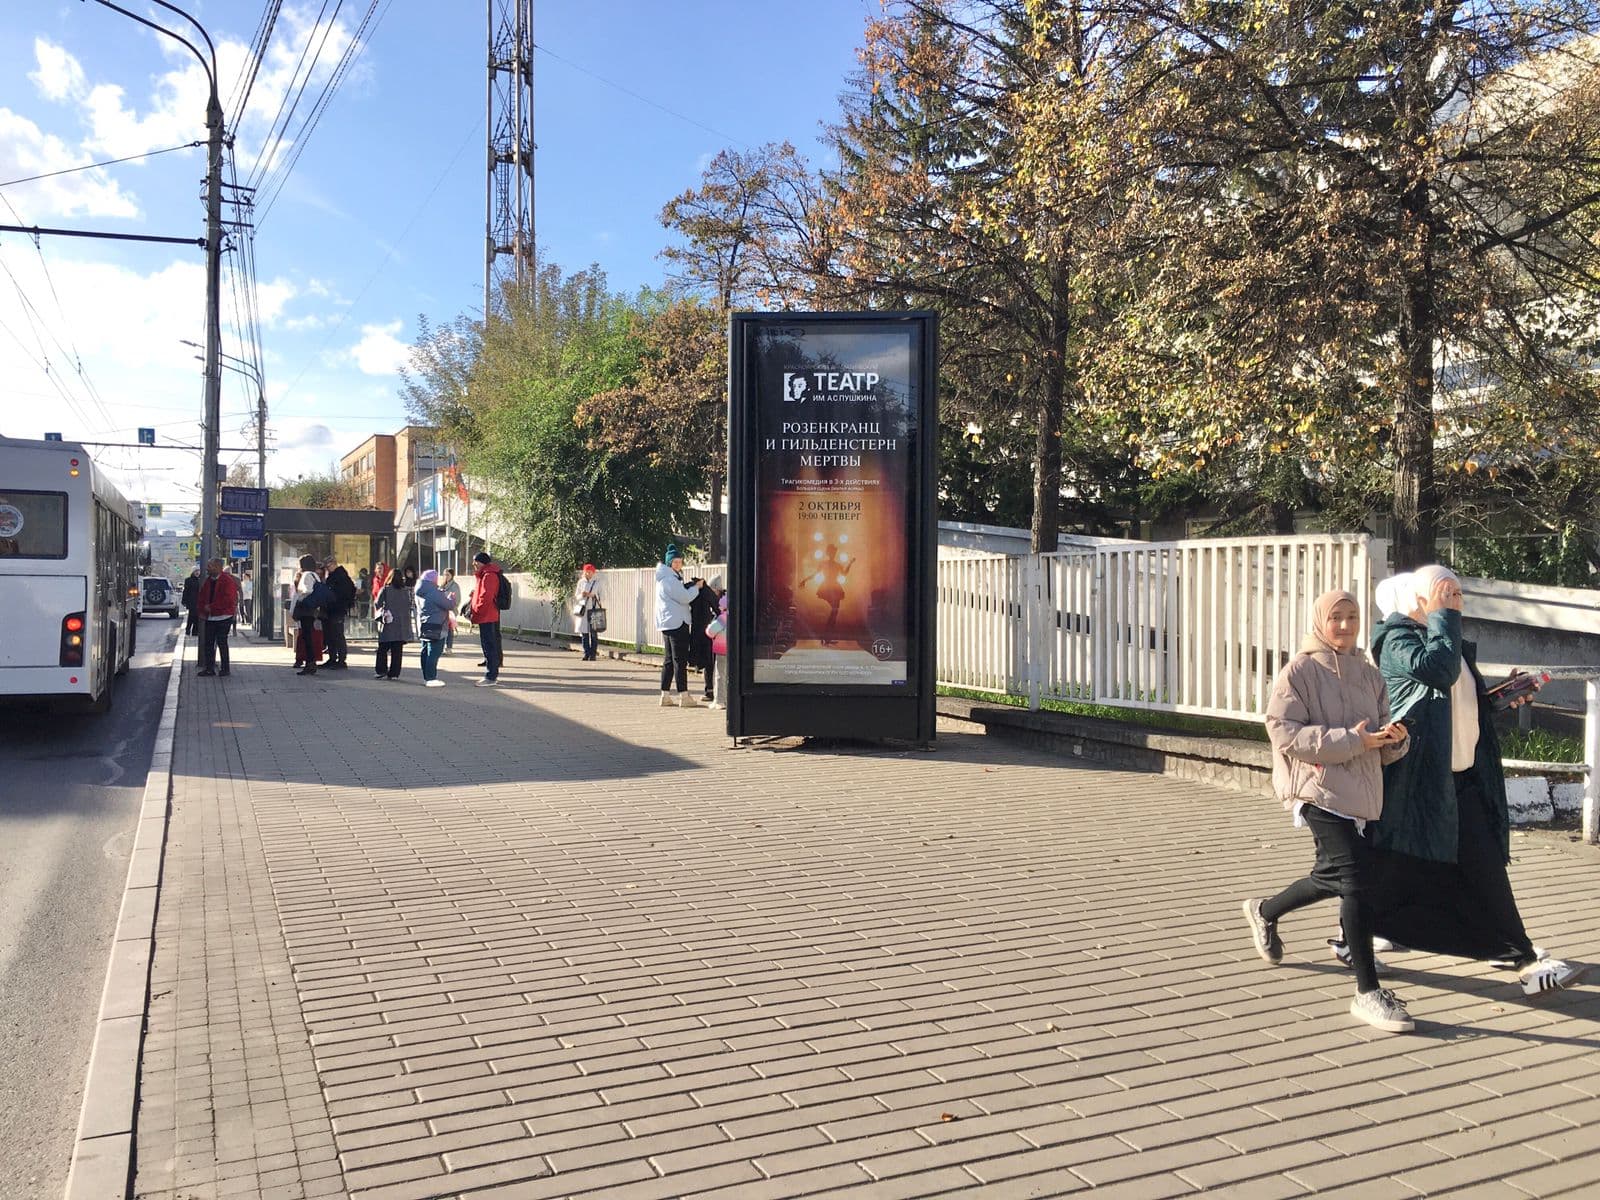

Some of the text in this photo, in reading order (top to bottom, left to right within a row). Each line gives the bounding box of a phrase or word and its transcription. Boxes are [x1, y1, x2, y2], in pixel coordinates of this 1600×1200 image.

[813, 372, 880, 391] ТЕАТР
[782, 422, 881, 435] РОЗЕНКРАНЦ
[765, 438, 897, 451] И ГИЛЬДЕНСТЕРН
[800, 455, 861, 467] МЕРТВЫ
[799, 501, 861, 511] 2 ОКТЯБРЯ
[798, 512, 861, 521] 19:00 ЧЕТВЕРГ
[873, 643, 892, 654] 16+
